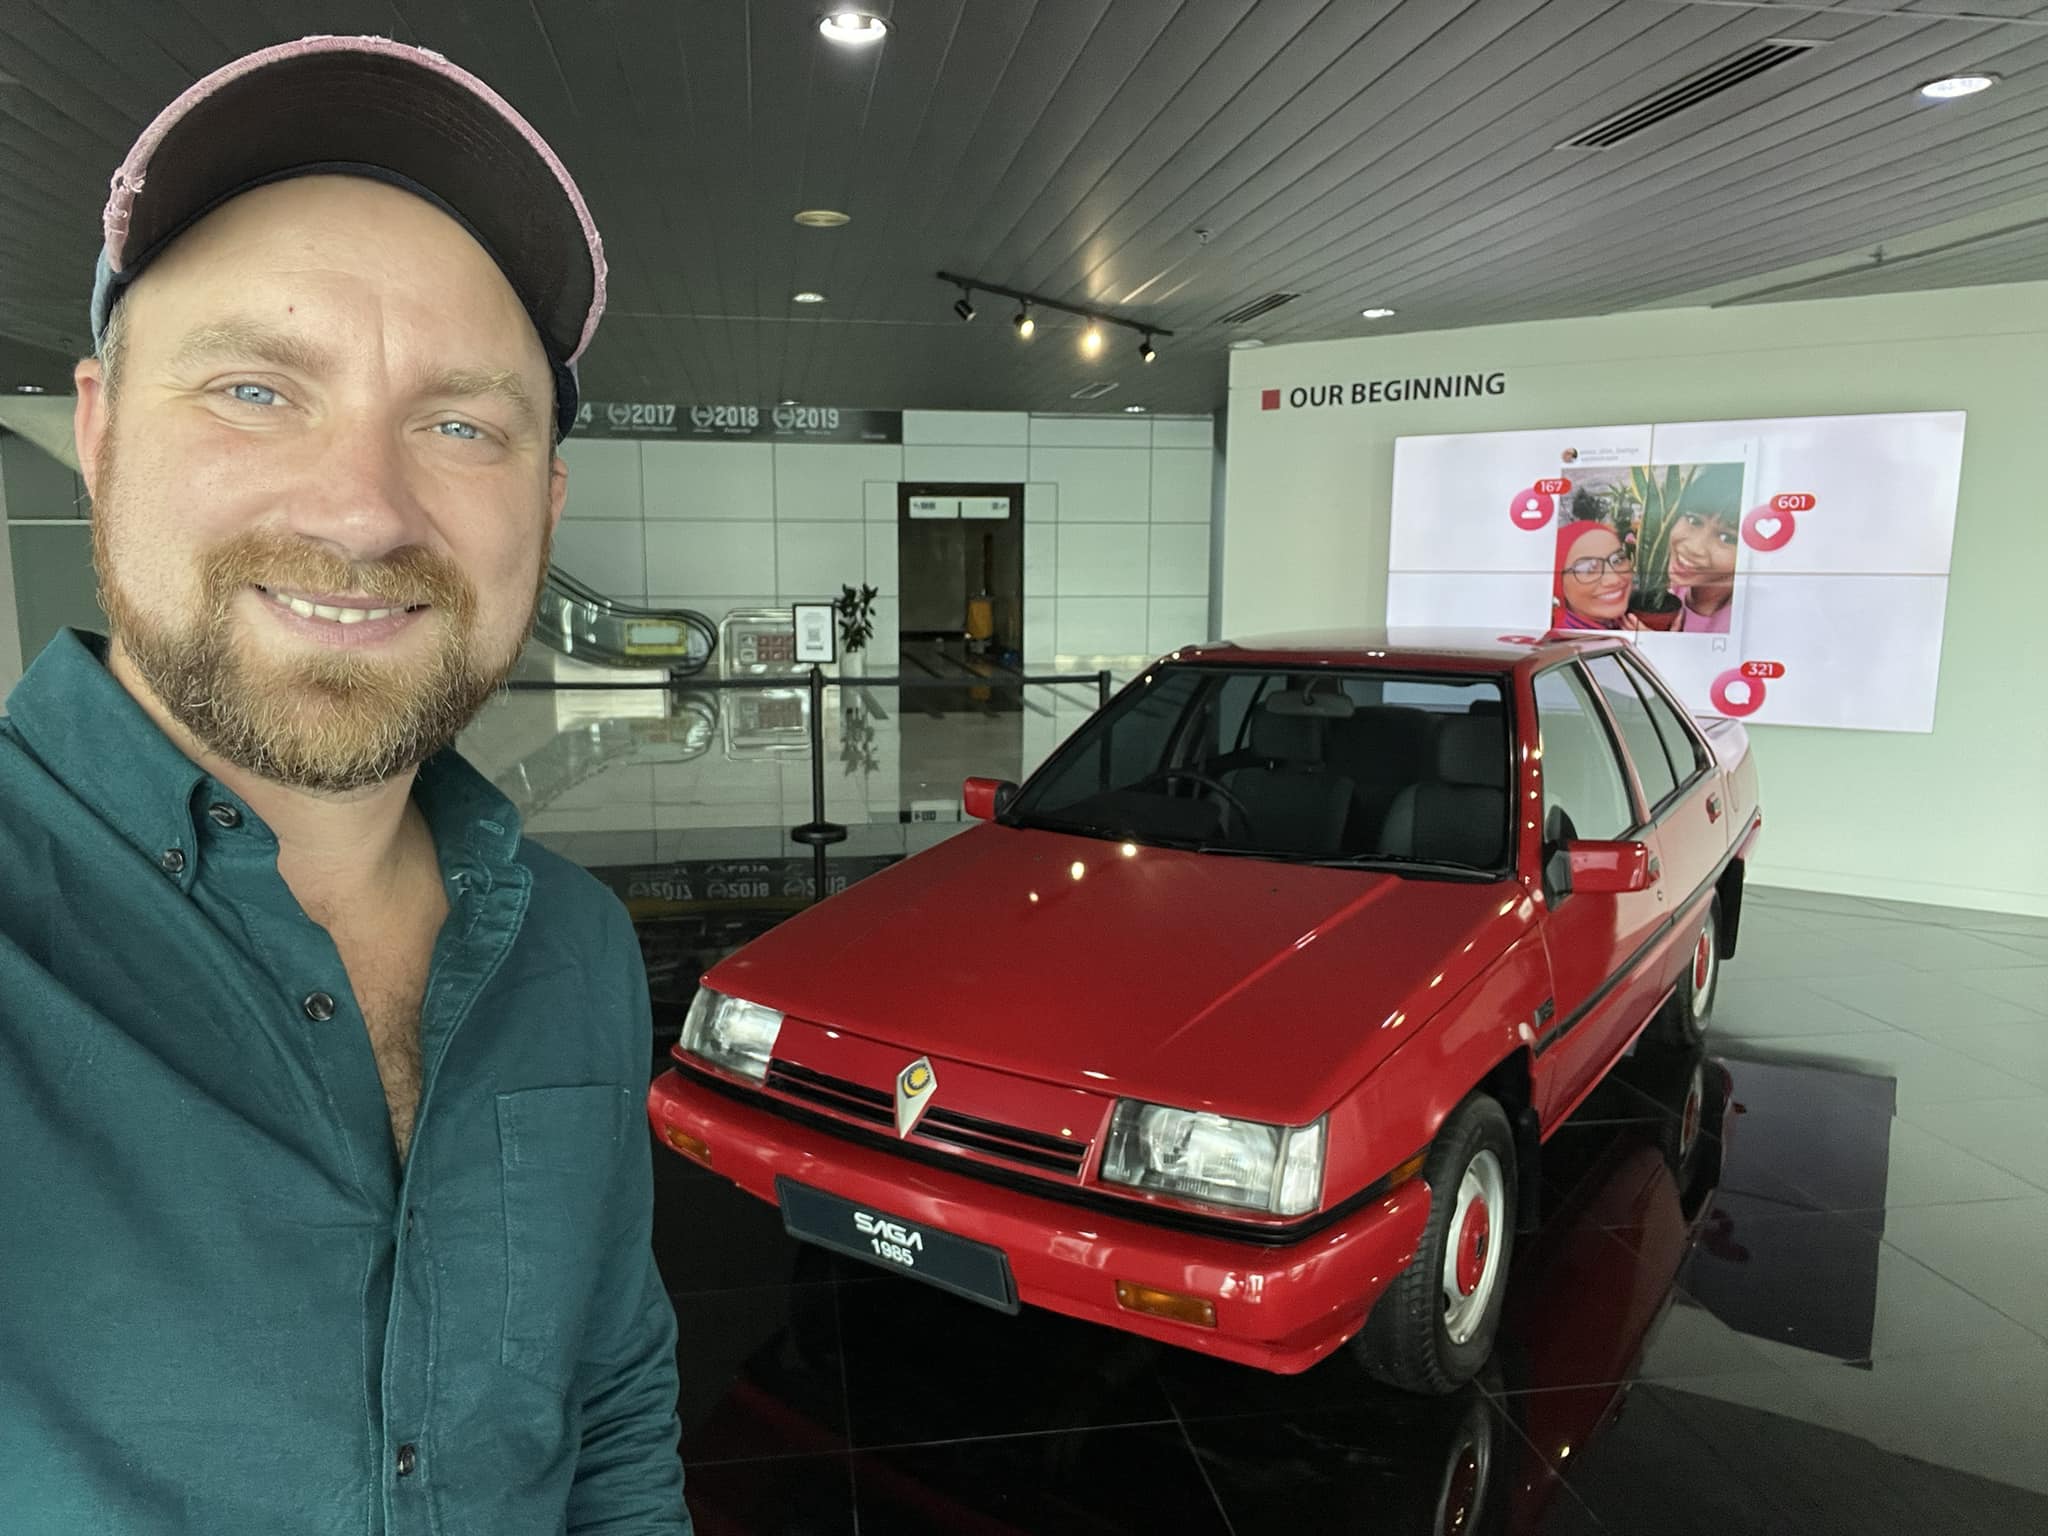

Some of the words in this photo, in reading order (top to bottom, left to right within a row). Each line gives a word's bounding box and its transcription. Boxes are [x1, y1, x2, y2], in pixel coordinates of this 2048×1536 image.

[1289, 384, 1344, 409] OUR
[1350, 372, 1507, 405] BEGINNING
[631, 403, 677, 425] 2017
[714, 405, 760, 427] 2018
[795, 407, 840, 429] 2019
[1540, 480, 1563, 493] 167
[1777, 494, 1806, 509] 601
[1747, 663, 1774, 677] 321
[853, 1211, 923, 1251] SAGA
[871, 1238, 914, 1267] 1985
